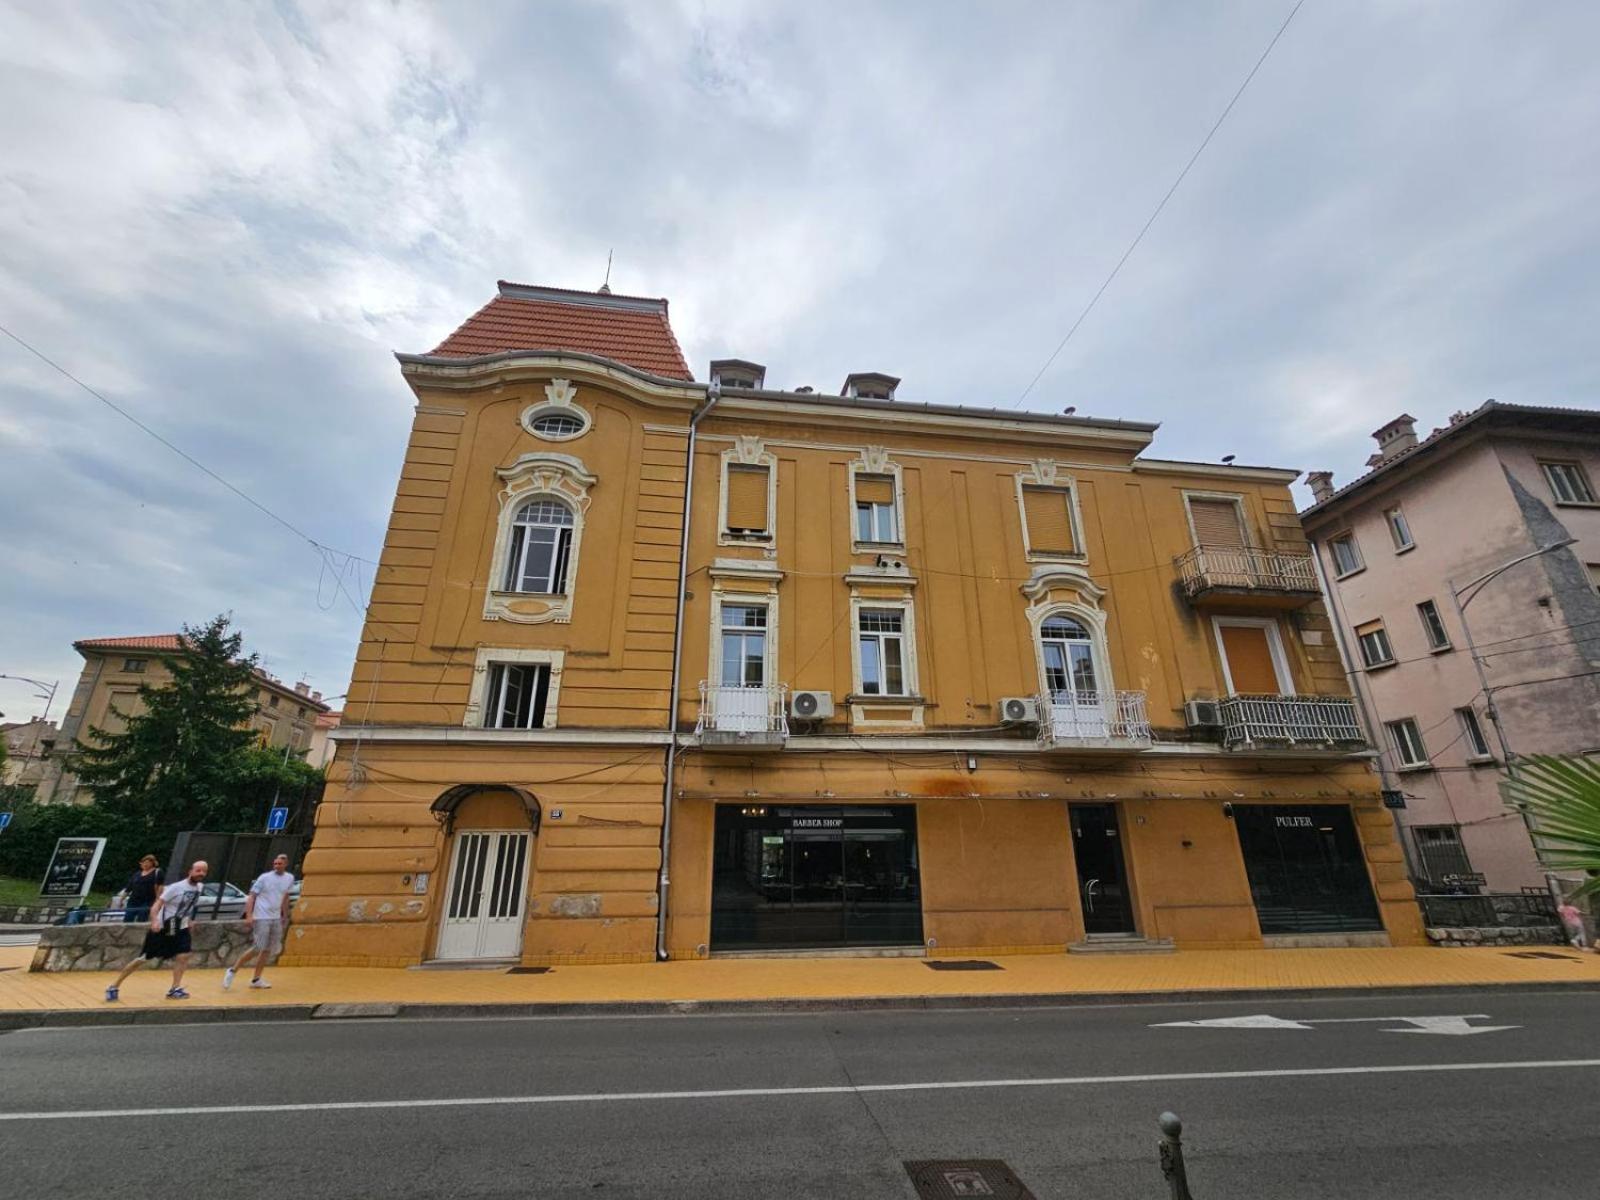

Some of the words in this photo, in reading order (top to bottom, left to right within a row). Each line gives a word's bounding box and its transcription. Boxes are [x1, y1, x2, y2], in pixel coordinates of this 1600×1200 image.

[793, 819, 821, 827] BARBER
[823, 819, 842, 827] SHOP
[1275, 816, 1313, 827] PULFER
